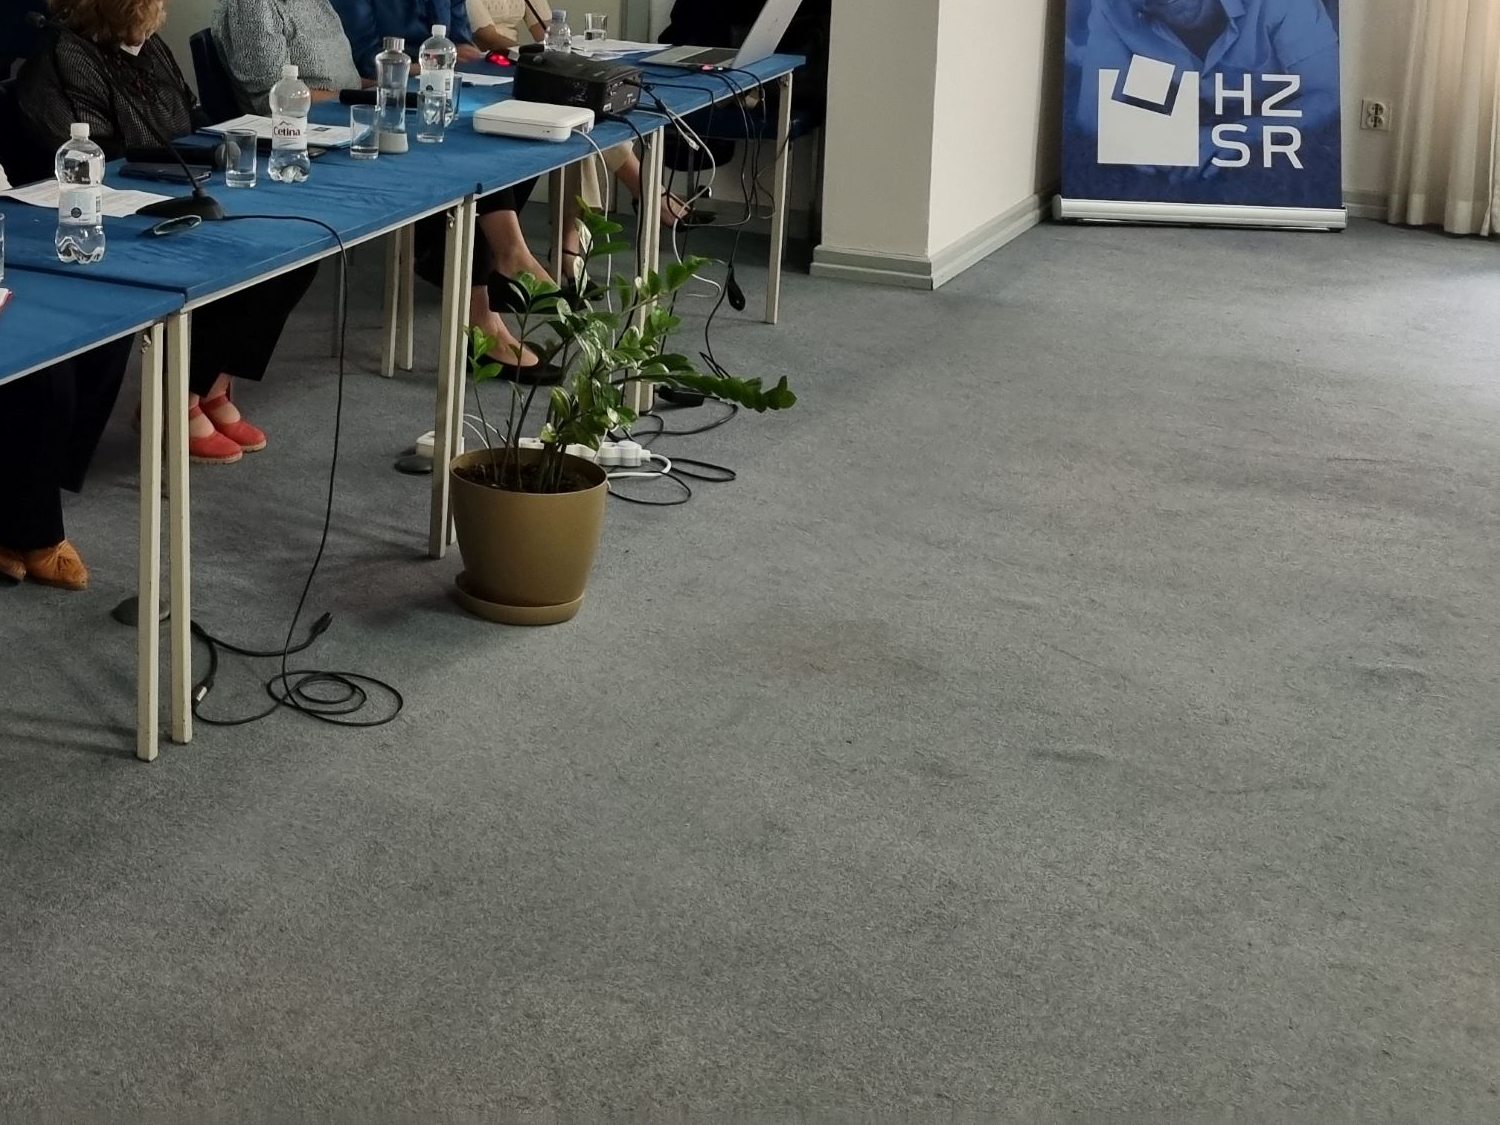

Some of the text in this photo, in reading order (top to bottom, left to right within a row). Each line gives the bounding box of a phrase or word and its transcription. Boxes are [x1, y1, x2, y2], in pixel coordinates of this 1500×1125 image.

[1215, 73, 1302, 117] HZ
[273, 126, 301, 137] Cetina
[1211, 124, 1304, 168] SR
